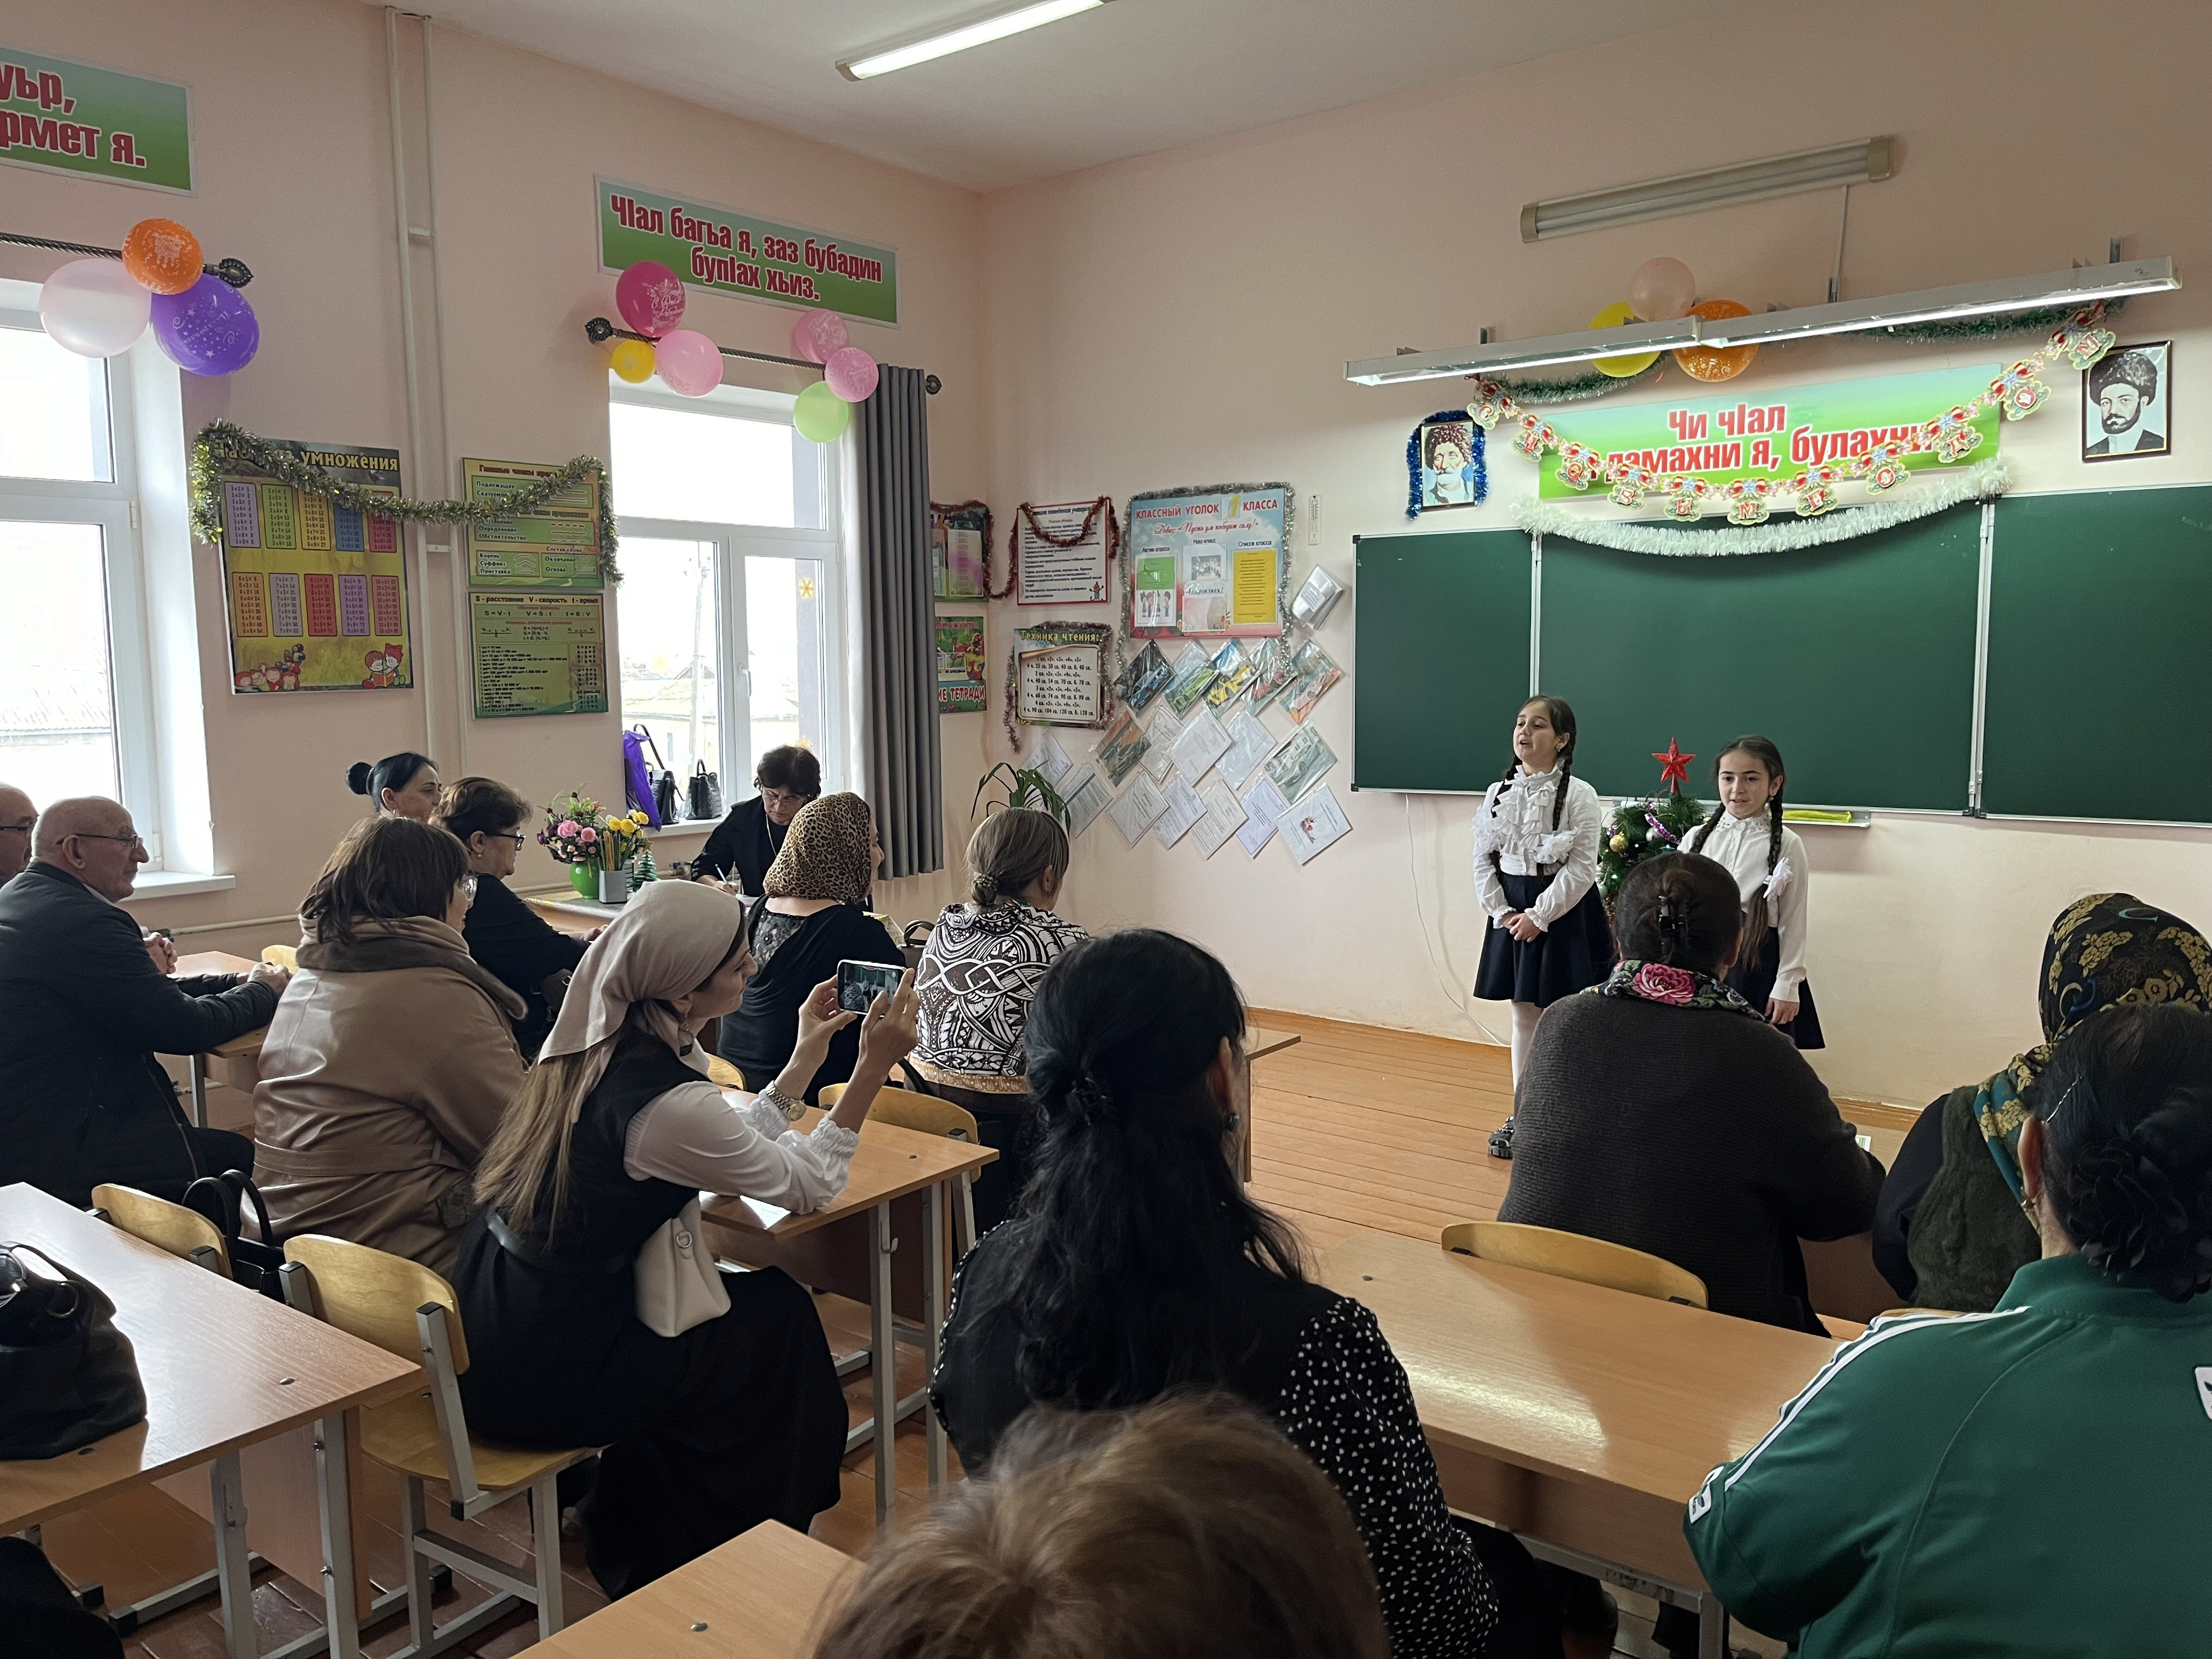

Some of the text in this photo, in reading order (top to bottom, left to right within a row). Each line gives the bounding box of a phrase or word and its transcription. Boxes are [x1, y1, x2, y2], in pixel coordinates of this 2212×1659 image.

[112, 133, 145, 167] я.
[670, 207, 732, 249] багьа
[738, 230, 757, 258] я,
[764, 236, 799, 264] заз
[804, 239, 882, 283] бубадин
[766, 268, 820, 300] хьиз.
[1669, 410, 1707, 441] Чи
[300, 450, 398, 471] умножения
[1751, 439, 1780, 470] я,
[1136, 505, 1181, 520] КЛАССНЫЙ
[1186, 504, 1220, 515] УГОЛОК
[1243, 499, 1278, 511] КЛАССА
[1020, 630, 1099, 642] Техника чтения:
[950, 686, 985, 702] ТЕТРАДИ
